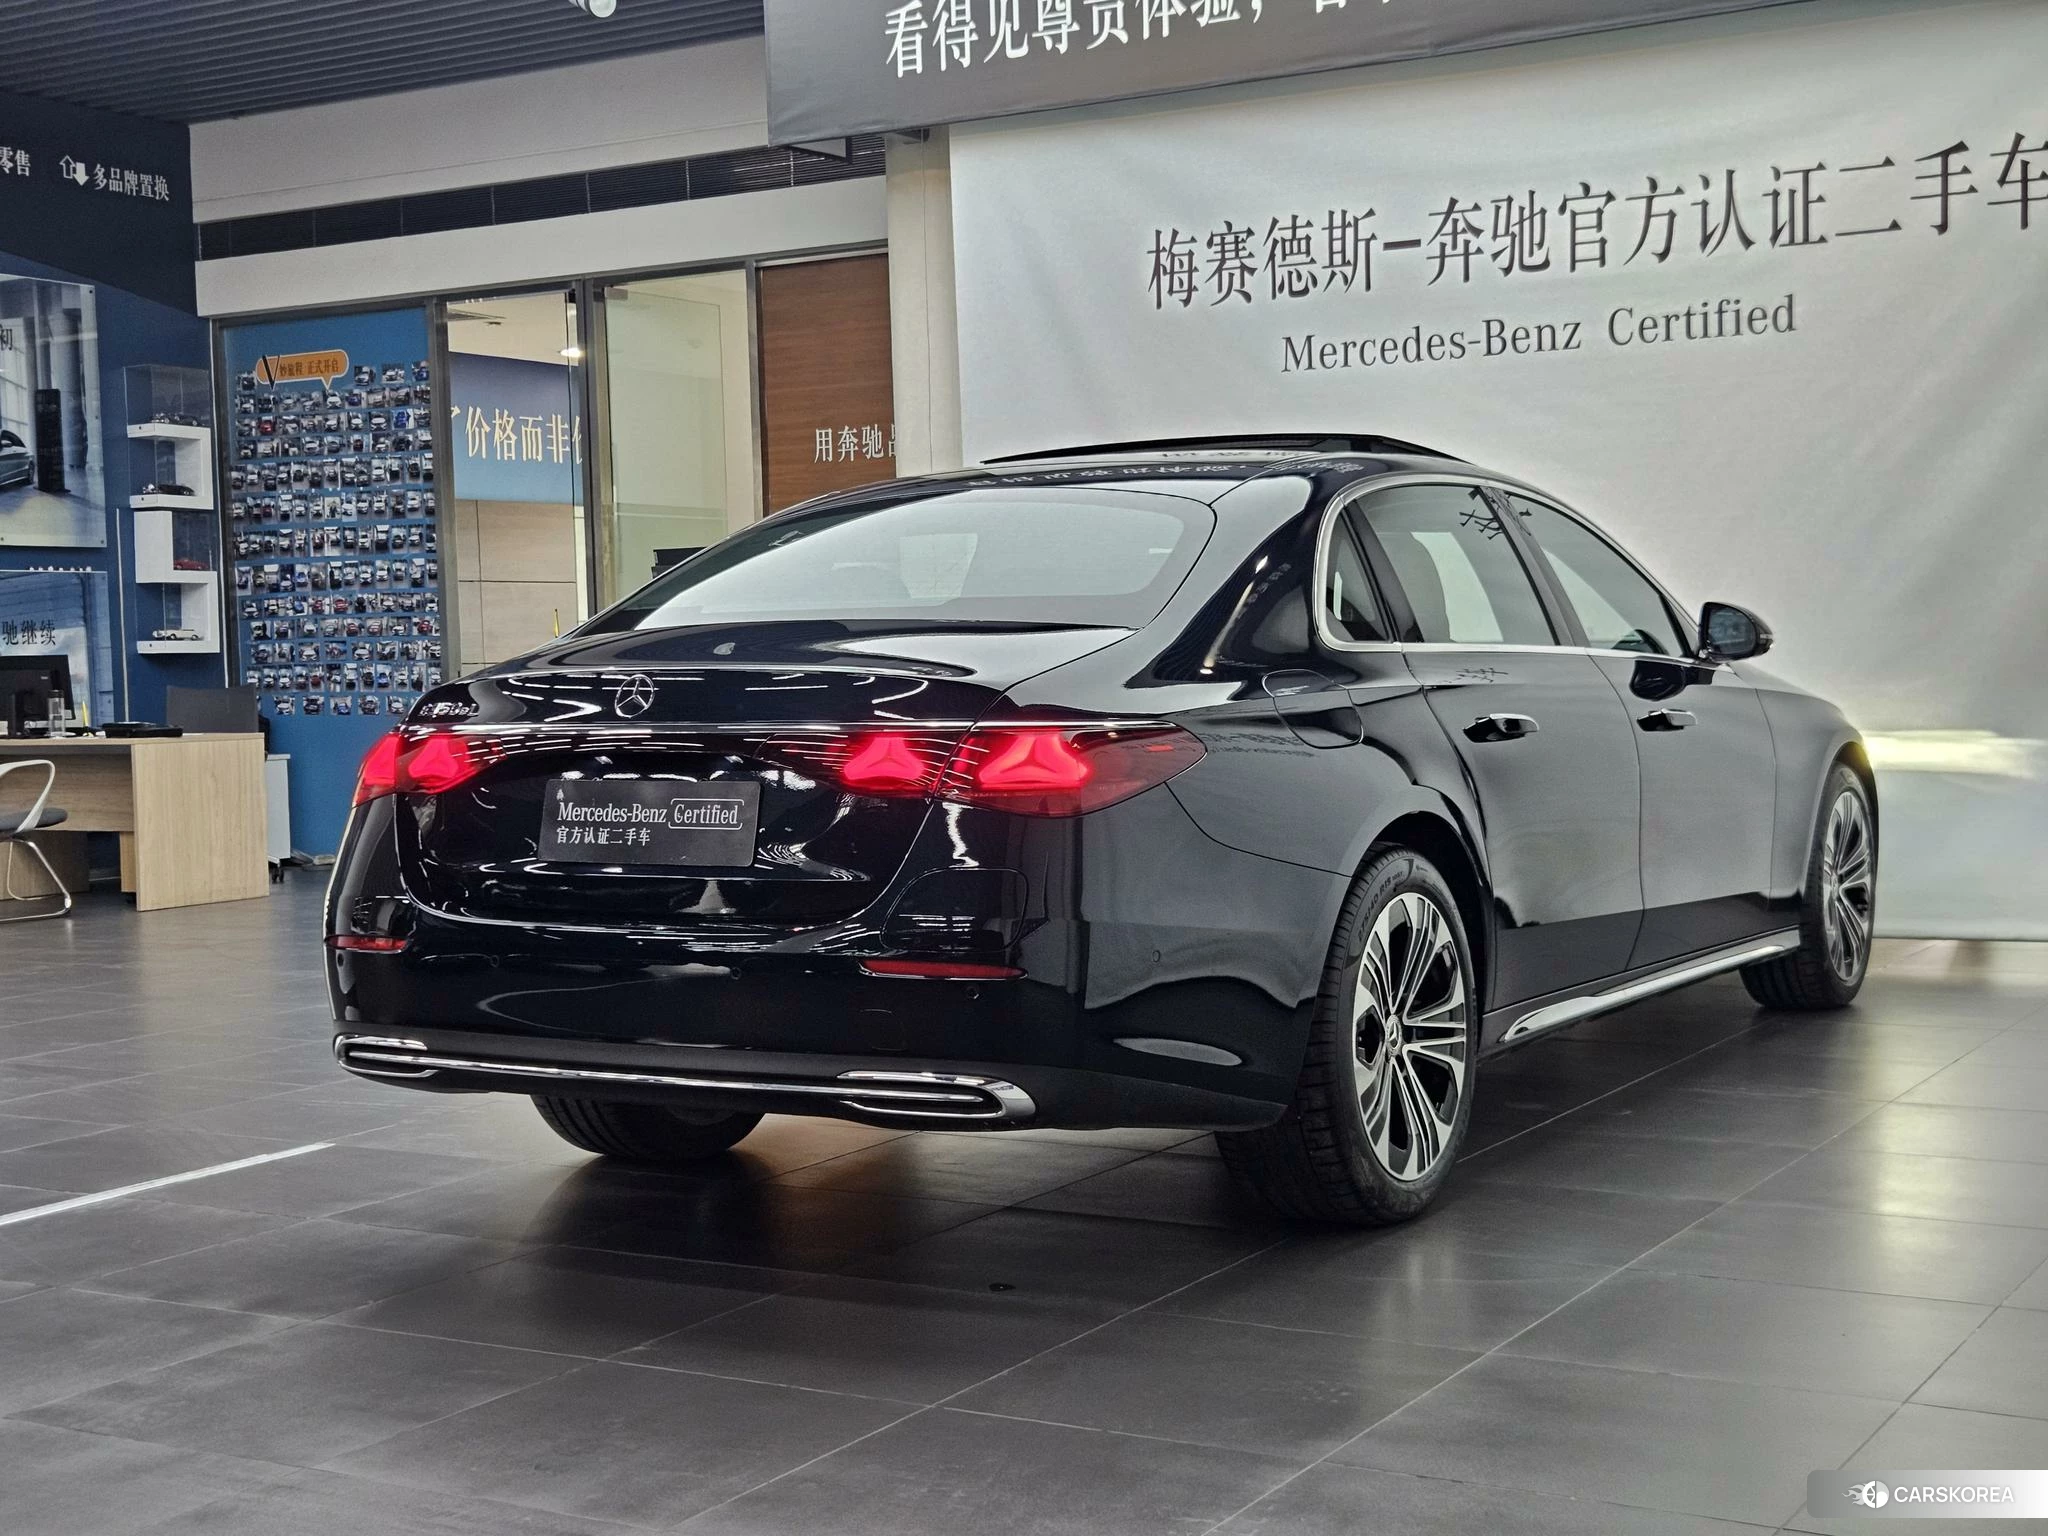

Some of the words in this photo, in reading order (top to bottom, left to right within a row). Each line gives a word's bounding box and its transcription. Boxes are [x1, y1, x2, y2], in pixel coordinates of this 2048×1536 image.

[93, 163, 170, 201] 多品牌置换
[1281, 318, 1582, 374] Mercedes-Benz
[1607, 294, 1797, 347] Certified
[2, 619, 57, 646] 驰继续
[556, 802, 667, 823] Mercedes-Benz
[674, 803, 739, 825] Certified
[556, 825, 651, 847] 官方认证二手车
